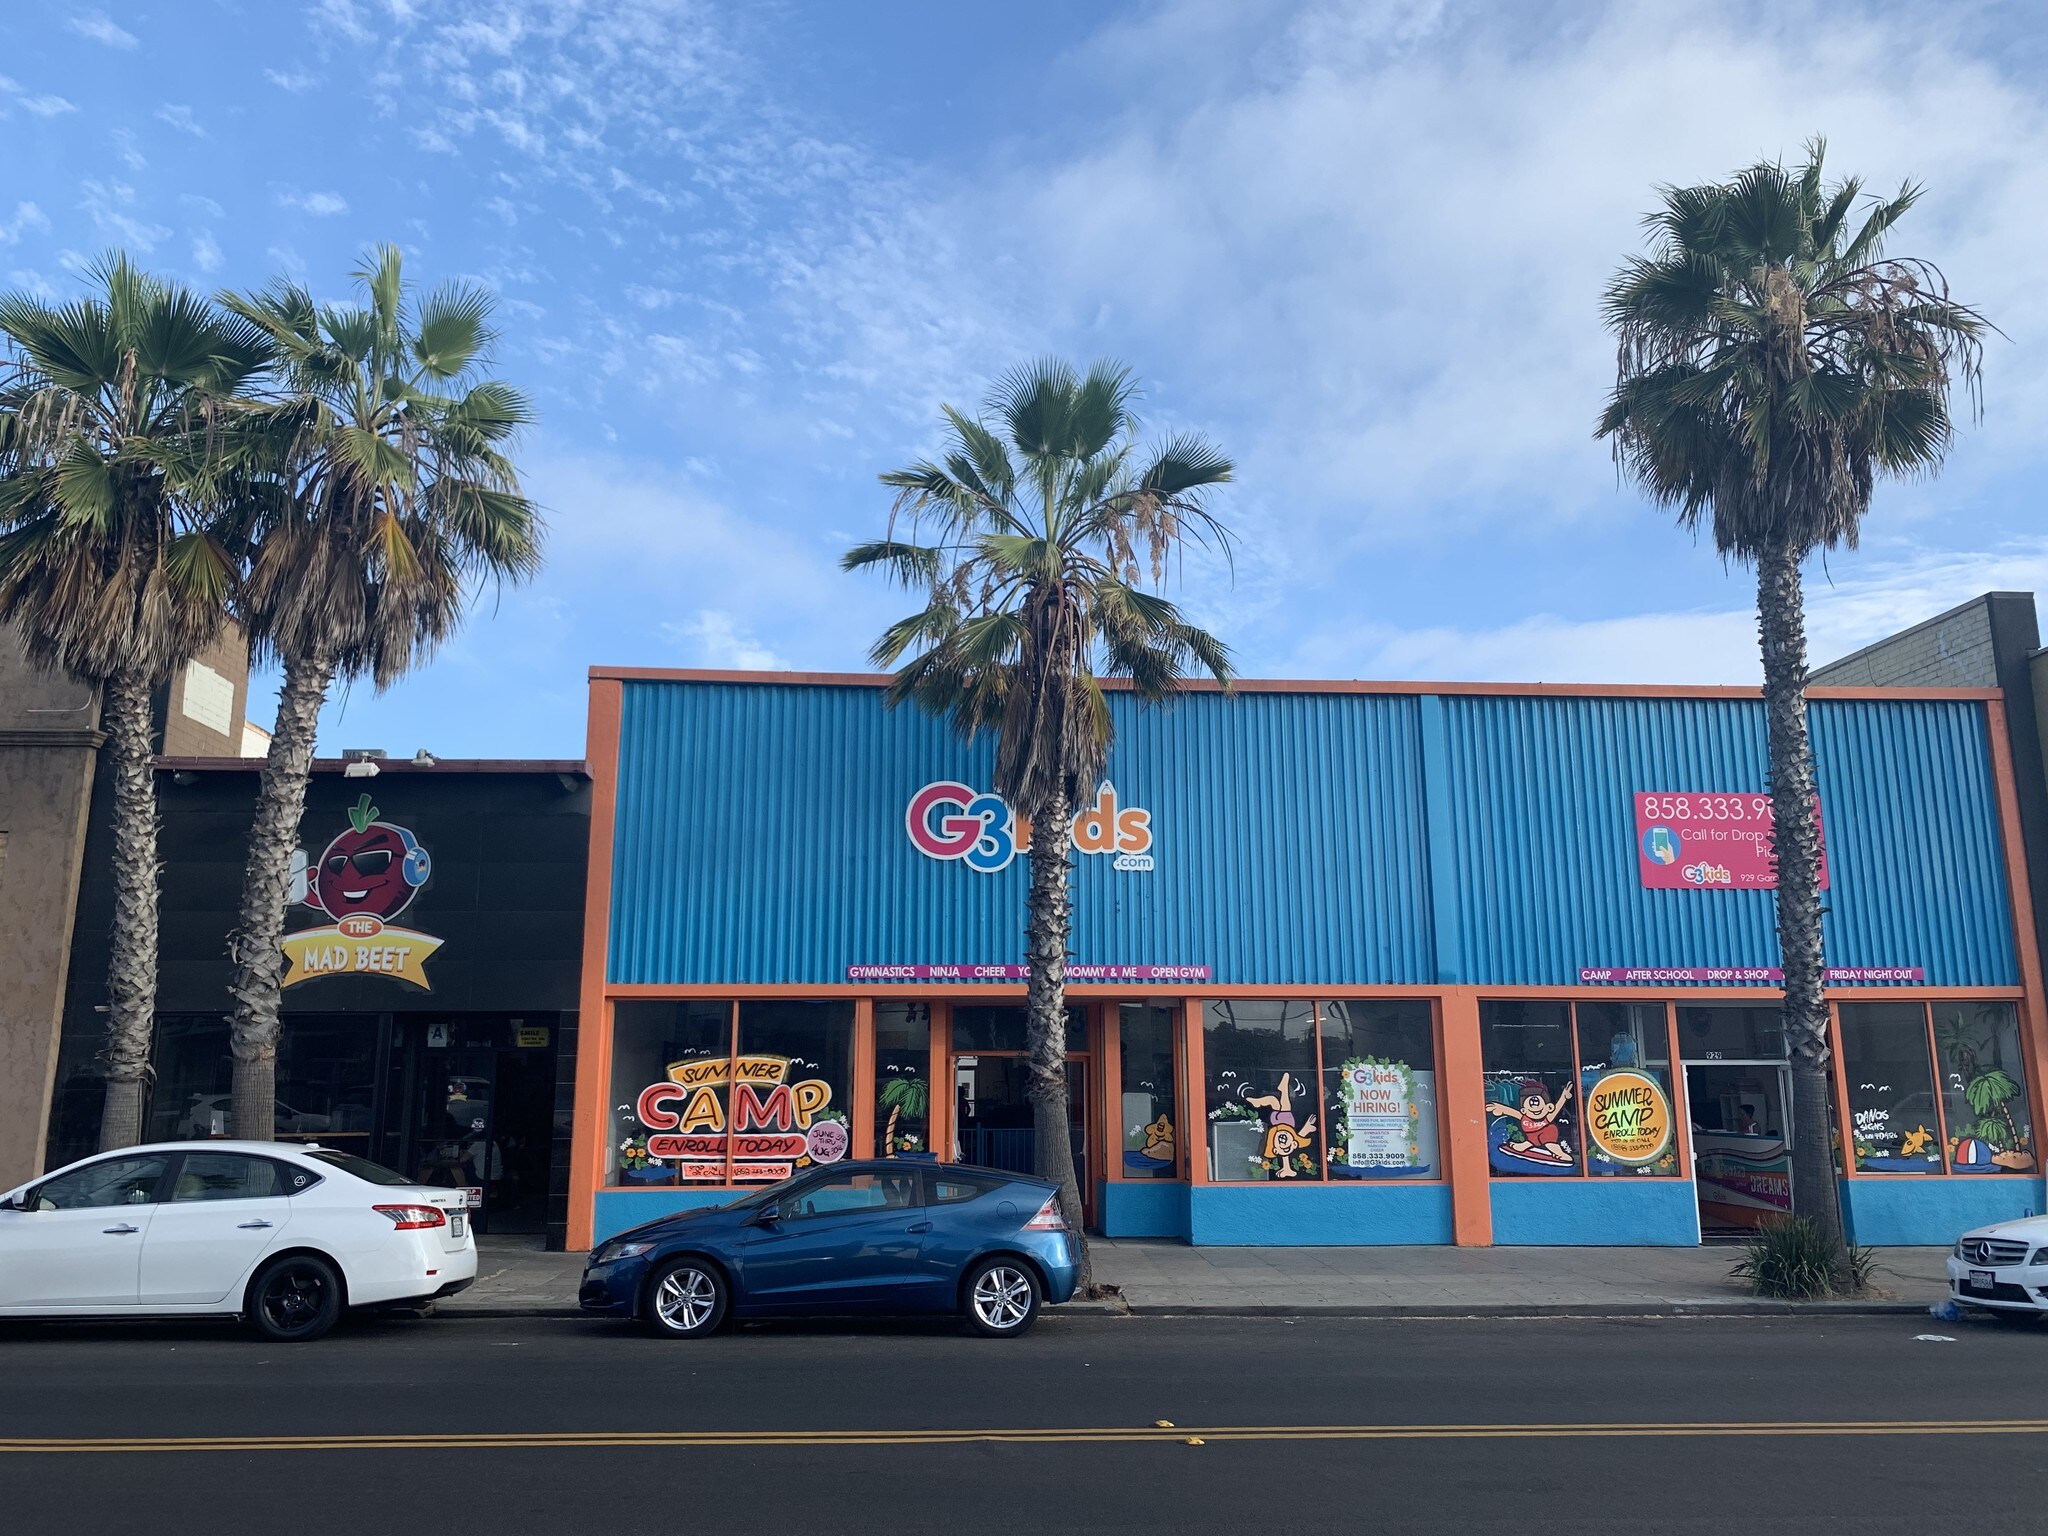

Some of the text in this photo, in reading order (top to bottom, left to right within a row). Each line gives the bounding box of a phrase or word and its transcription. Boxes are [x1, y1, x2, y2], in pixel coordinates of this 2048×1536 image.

[1645, 797, 1776, 820] 858.333.9
[909, 782, 1153, 868] G3ds
[1681, 828, 1707, 840] Call
[1711, 828, 1728, 840] for
[1732, 829, 1764, 845] Drop
[1756, 846, 1778, 857] Pic
[1683, 863, 1730, 883] G3kids
[1740, 873, 1754, 882] 929
[347, 920, 373, 934] THE
[304, 946, 411, 973] MAD BEET
[850, 966, 915, 977] GYMNASTICS
[929, 966, 960, 977] NINJA
[974, 966, 1006, 977] CHEER
[1063, 966, 1106, 977] MOMMY
[1110, 967, 1118, 977] &
[1121, 967, 1137, 977] ME
[1150, 967, 1178, 978] OPEN
[1180, 967, 1205, 978] GYM
[1581, 970, 1913, 980] CAMP AFTER SCHOOL DROP & SHOP FRIDAY NIGHT OUT
[431, 1027, 443, 1039] A
[682, 1062, 781, 1083] SUMMER
[1354, 1069, 1398, 1086] G3kids
[1360, 1090, 1391, 1100] NOW
[1593, 1087, 1654, 1112] SUMMER
[637, 1079, 833, 1134] CAMP
[1353, 1102, 1400, 1113] HIRING!
[1595, 1107, 1654, 1129] CAMP
[1854, 1108, 1889, 1125] DANOS
[1603, 1126, 1662, 1140] ENROLL TODAY
[1860, 1122, 1885, 1131] SIGNS
[812, 1130, 835, 1138] JUNE
[656, 1138, 796, 1152] ENROLL TODAY
[818, 1138, 836, 1146] THRU
[811, 1144, 830, 1157] AUG
[1750, 1175, 1789, 1196] DREAMS
